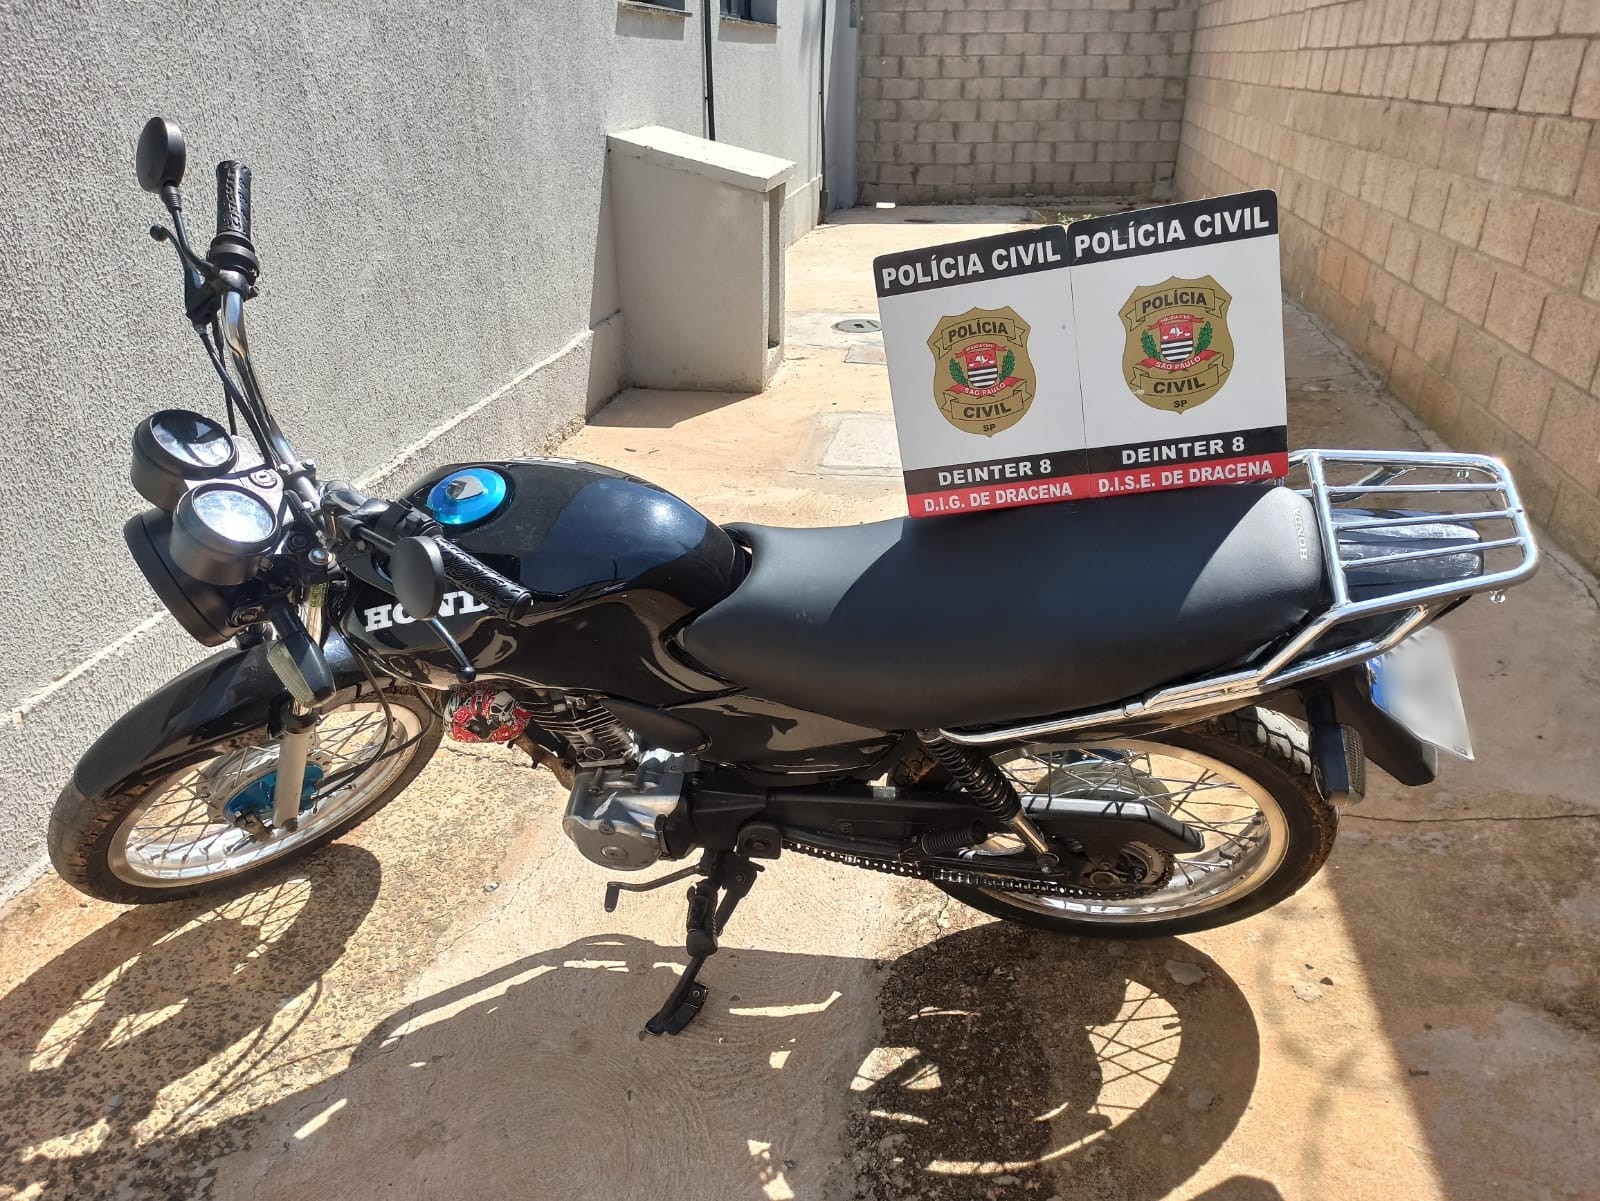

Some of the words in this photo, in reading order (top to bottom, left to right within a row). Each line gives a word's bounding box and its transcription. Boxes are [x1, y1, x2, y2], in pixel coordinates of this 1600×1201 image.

[1074, 219, 1186, 258] POLÍCIA
[1194, 206, 1270, 238] CIVIL
[882, 254, 985, 289] POLÍCIA
[991, 240, 1061, 271] CIVIL
[1142, 289, 1208, 314] POLÍCIA
[948, 319, 1008, 343] POLÍCIA
[1174, 356, 1201, 370] PAULO
[982, 382, 1006, 396] PAULO
[1153, 376, 1206, 394] CIVIL
[963, 402, 1012, 419] CIVIL
[1173, 399, 1188, 408] SP
[983, 423, 996, 432] SP
[1122, 439, 1224, 465] DEINTER
[1232, 436, 1245, 452] 8
[938, 461, 1032, 486] DEINTER
[1039, 458, 1052, 474] 8
[1098, 473, 1156, 493] D.I.S.E.
[1161, 470, 1183, 486] DE
[1189, 460, 1272, 483] DRACENA
[924, 494, 965, 512] D.I.G.
[969, 491, 990, 507] DE
[996, 482, 1072, 504] DRACENA
